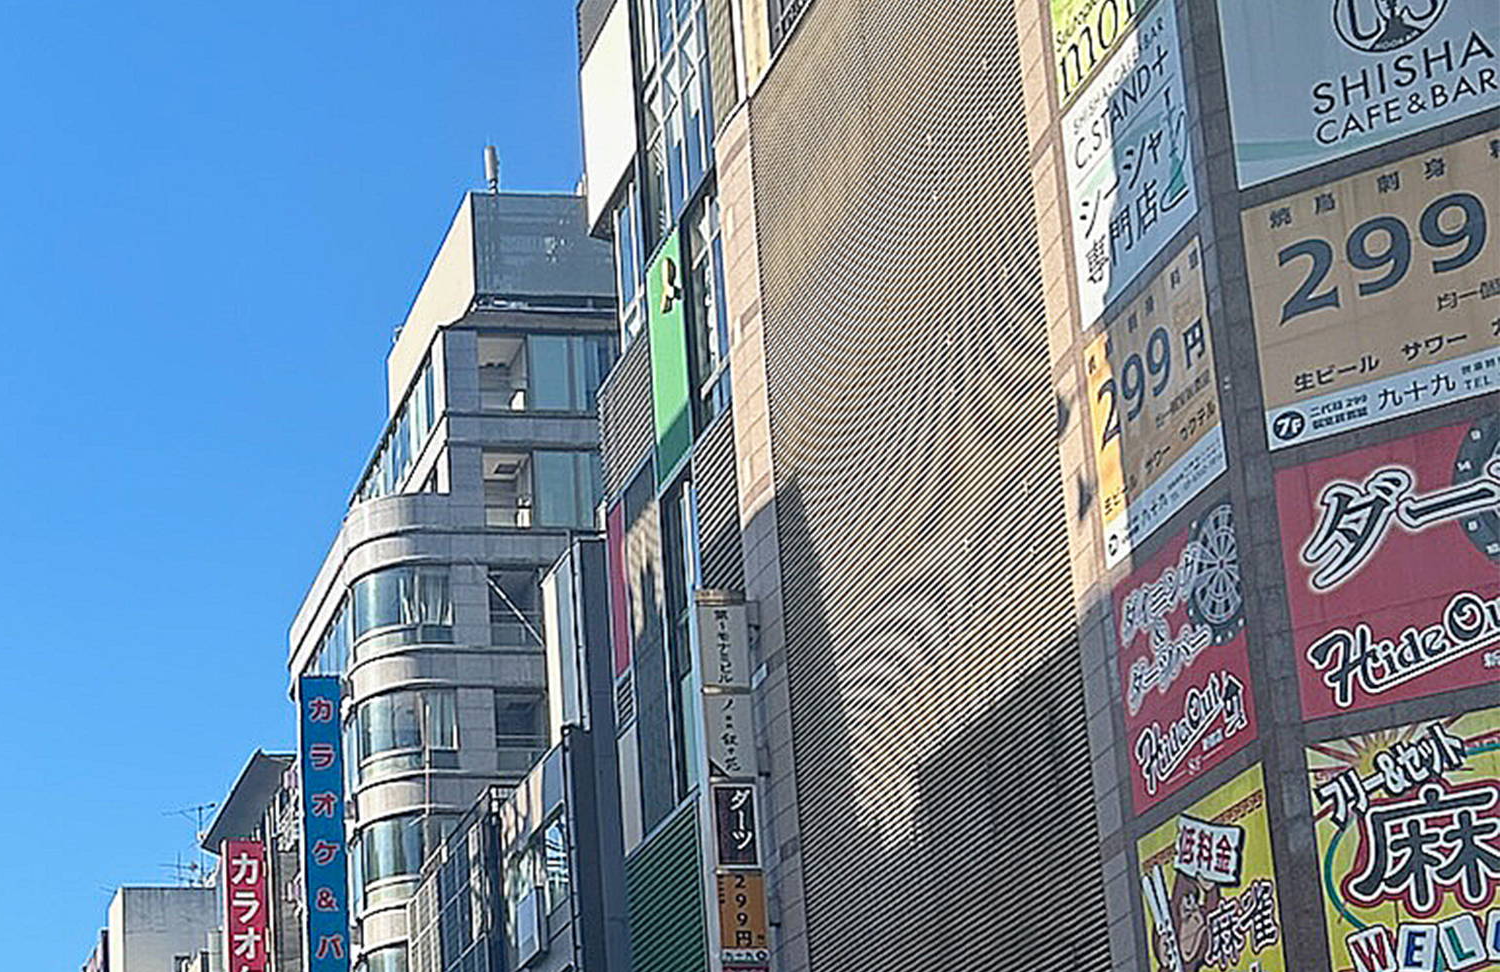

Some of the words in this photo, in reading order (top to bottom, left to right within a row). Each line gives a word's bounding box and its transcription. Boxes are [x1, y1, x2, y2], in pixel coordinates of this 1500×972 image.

[1075, 44, 1169, 170] C.STAND+
[1312, 31, 1495, 115] SHISHA
[1316, 68, 1498, 144] CAFE&BAR
[1079, 130, 1163, 239] シーシャ
[1278, 192, 1487, 327] 299
[1294, 355, 1380, 393] 生ビール
[1401, 334, 1468, 361] サワー
[1377, 373, 1456, 410] 九十九
[1316, 723, 1469, 831] フリー&セット
[730, 789, 753, 851] ダーツ
[735, 875, 752, 947] 299円
[1206, 879, 1279, 969] 麻雀
